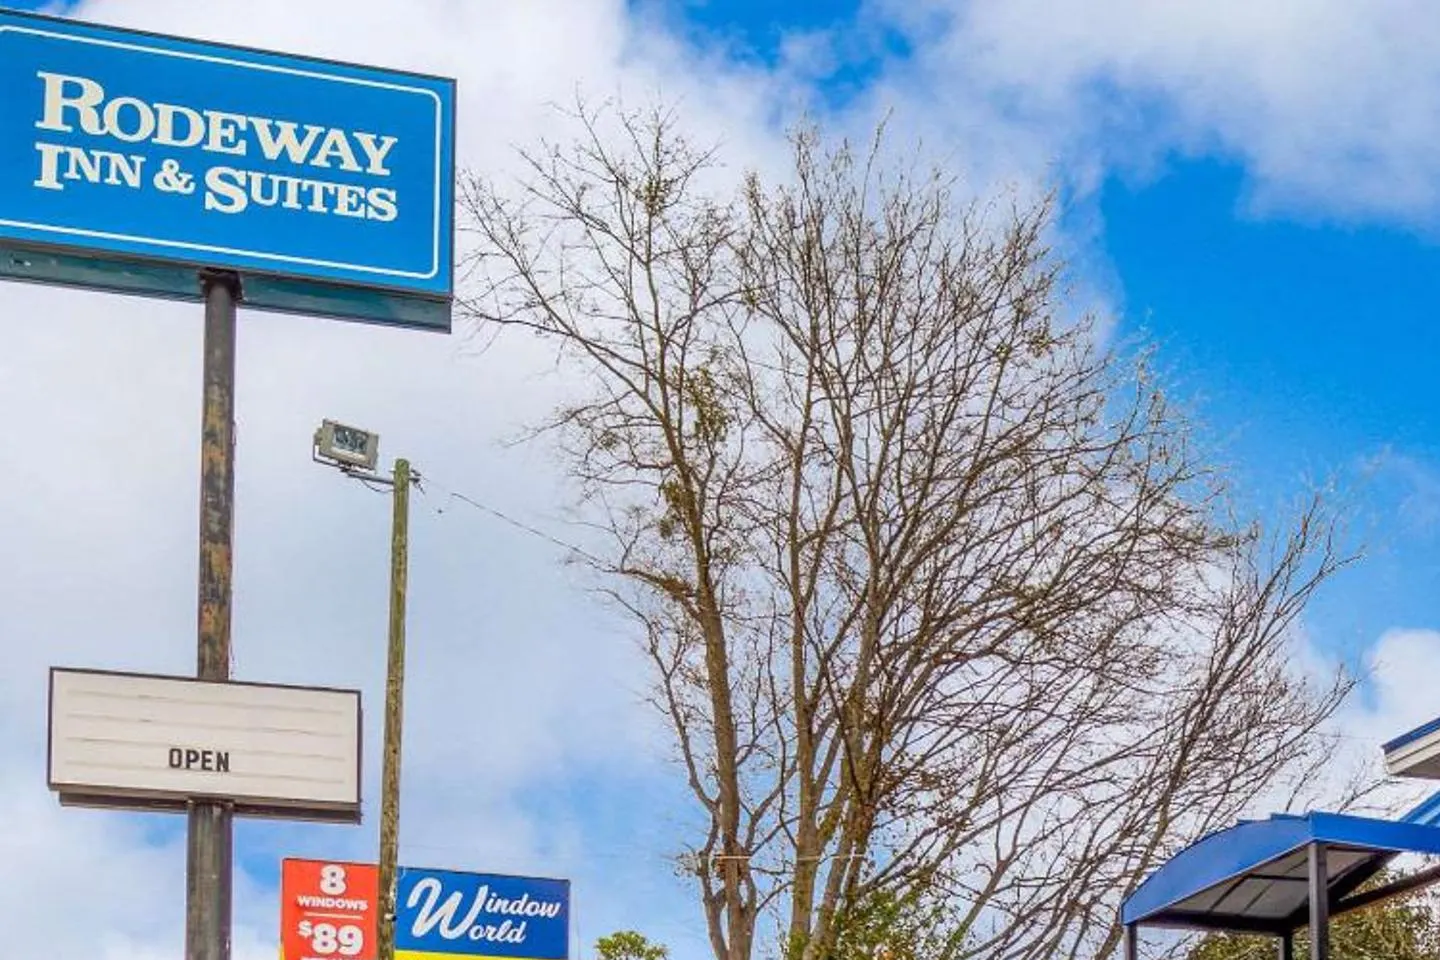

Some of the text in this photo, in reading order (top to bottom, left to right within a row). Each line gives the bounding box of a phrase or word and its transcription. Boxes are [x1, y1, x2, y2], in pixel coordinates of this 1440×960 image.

[35, 71, 398, 176] RODEWAY
[34, 142, 398, 222] INN & SUITES
[168, 748, 231, 772] OPEN
[320, 864, 346, 895] 8
[297, 896, 368, 911] WINDOWS
[298, 920, 364, 956] $89
